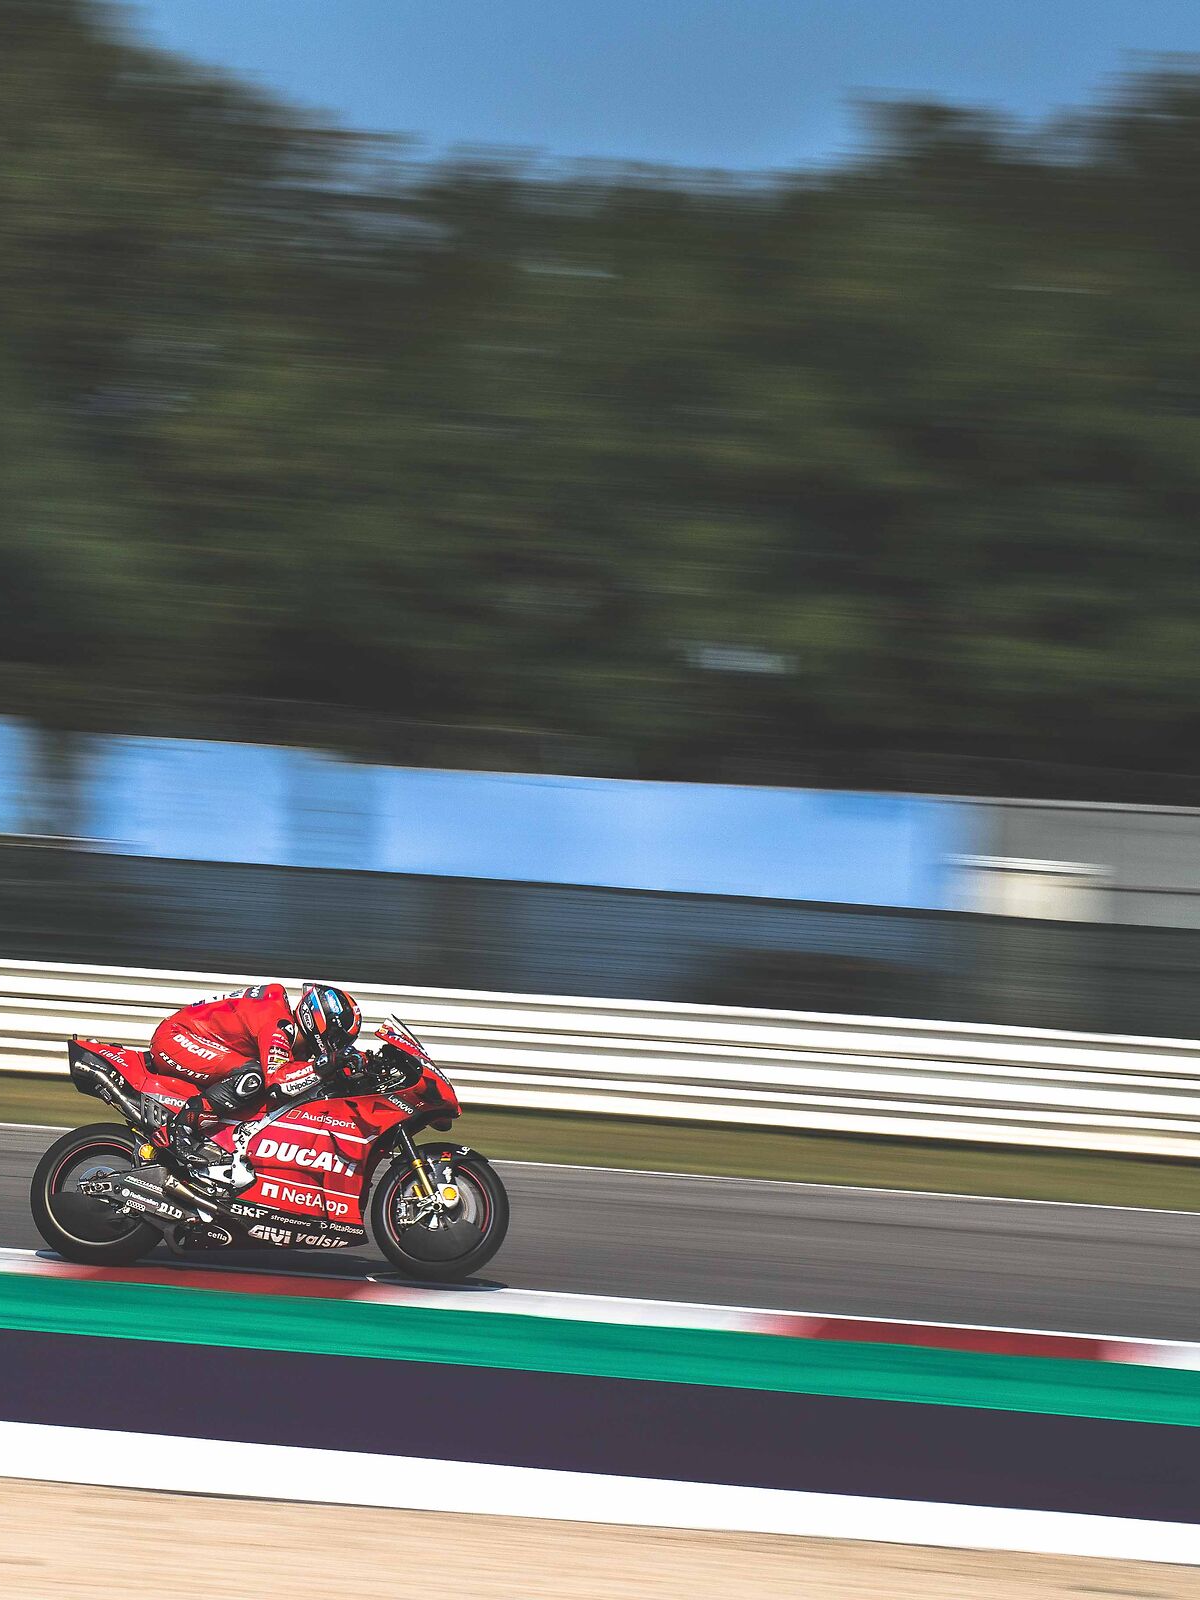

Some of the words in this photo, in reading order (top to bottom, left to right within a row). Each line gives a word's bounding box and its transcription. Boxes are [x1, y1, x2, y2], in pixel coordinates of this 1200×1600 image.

[172, 1033, 218, 1060] DUCATI
[160, 1095, 189, 1109] Leno
[388, 1094, 414, 1115] Lenovo
[255, 1138, 357, 1177] DUCATI
[230, 1203, 269, 1219] SKF
[281, 1187, 349, 1216] NetApp
[248, 1224, 293, 1246] GIVI
[329, 1222, 365, 1236] PittaRosso
[295, 1231, 349, 1249] valsir
